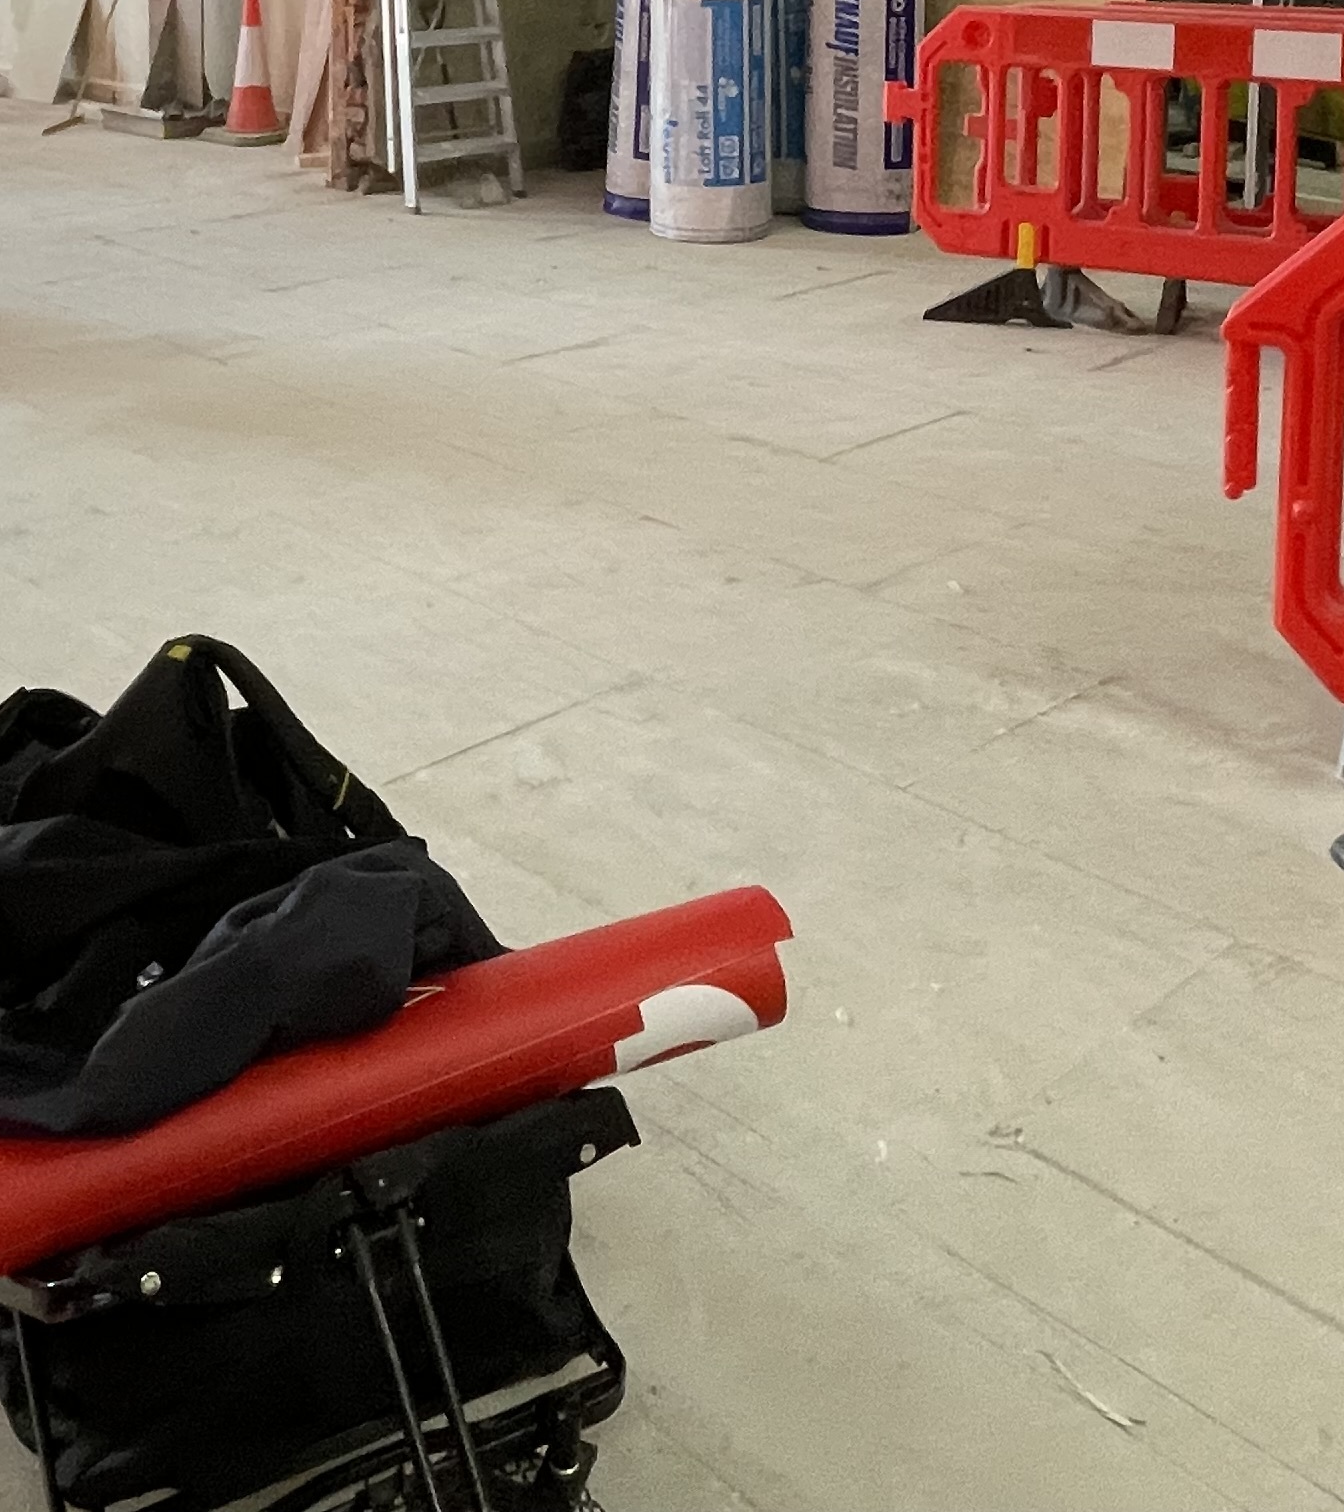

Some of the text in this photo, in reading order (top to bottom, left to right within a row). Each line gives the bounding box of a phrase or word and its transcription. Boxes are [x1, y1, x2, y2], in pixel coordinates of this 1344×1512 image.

[696, 84, 709, 108] 44
[695, 110, 712, 140] Roll
[832, 55, 860, 171] INSULATION
